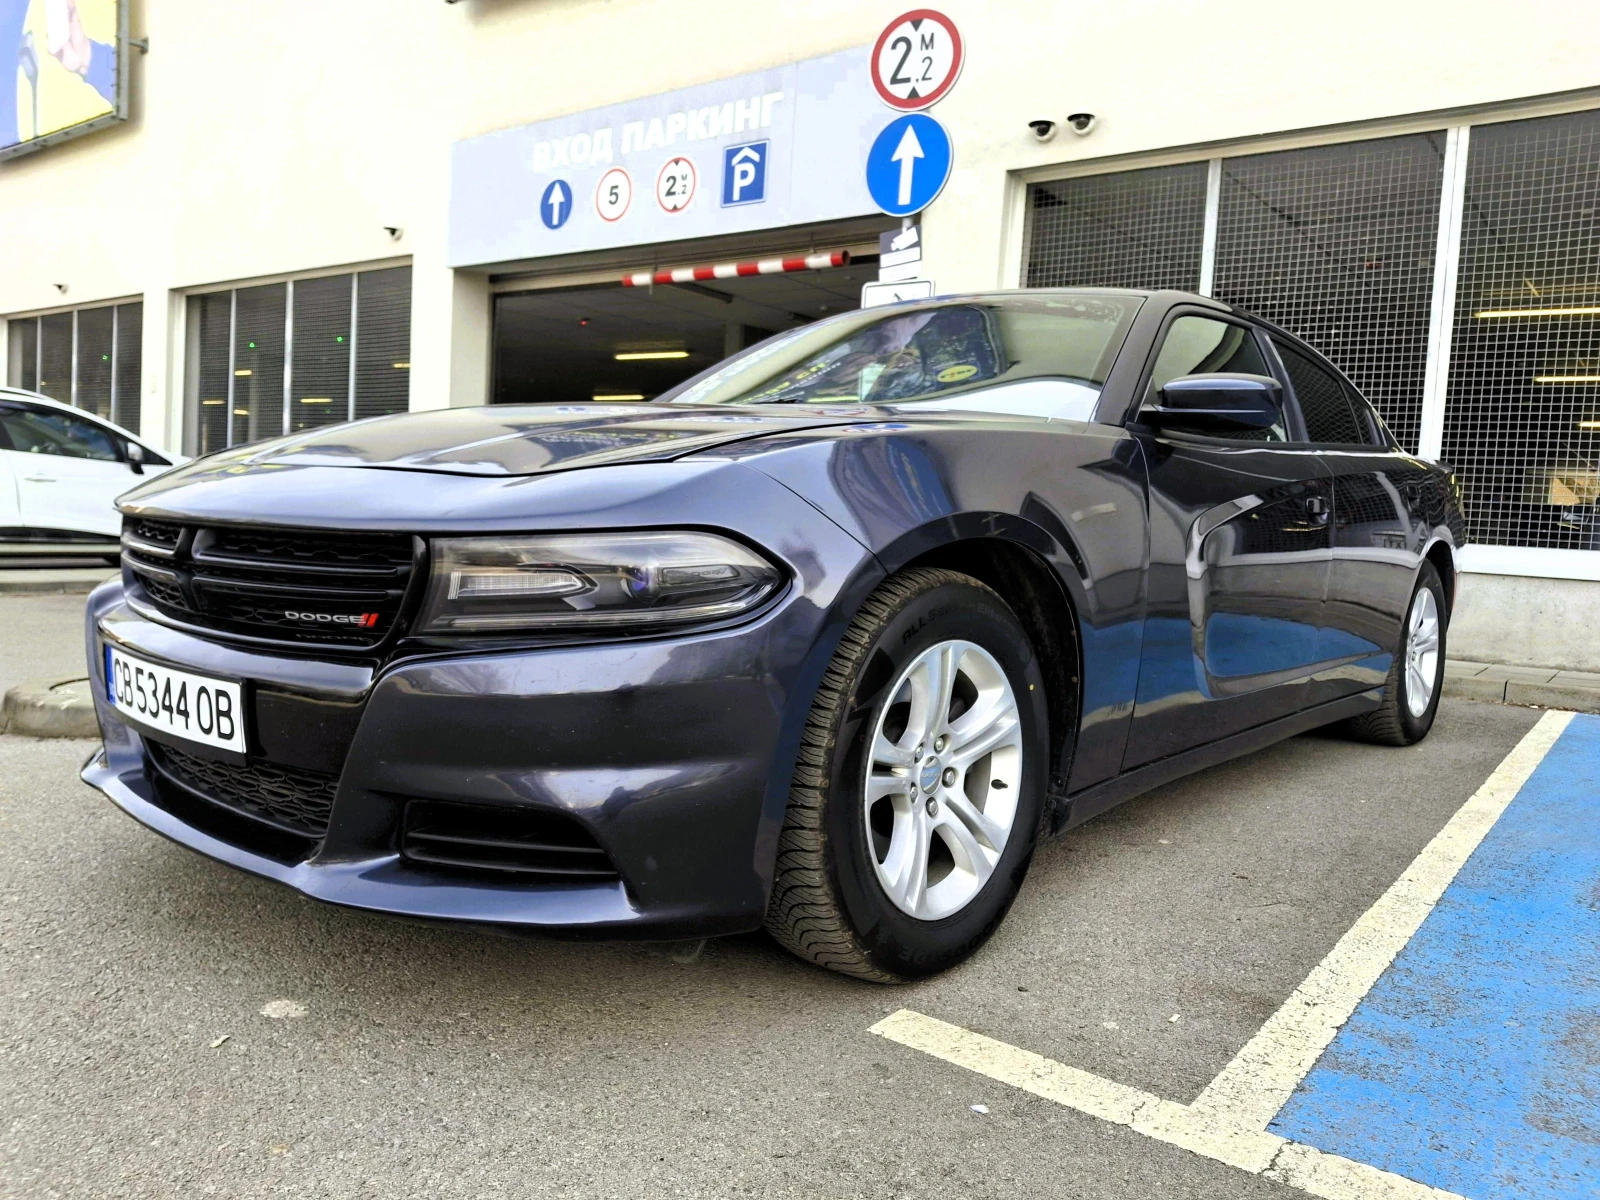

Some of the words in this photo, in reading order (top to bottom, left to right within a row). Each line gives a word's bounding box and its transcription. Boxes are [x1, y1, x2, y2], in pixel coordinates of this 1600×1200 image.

[533, 128, 613, 173] ВХОД
[621, 91, 784, 154] ПАРКИНГ
[608, 185, 620, 206] 5
[733, 162, 756, 201] P
[285, 611, 366, 624] DODGE
